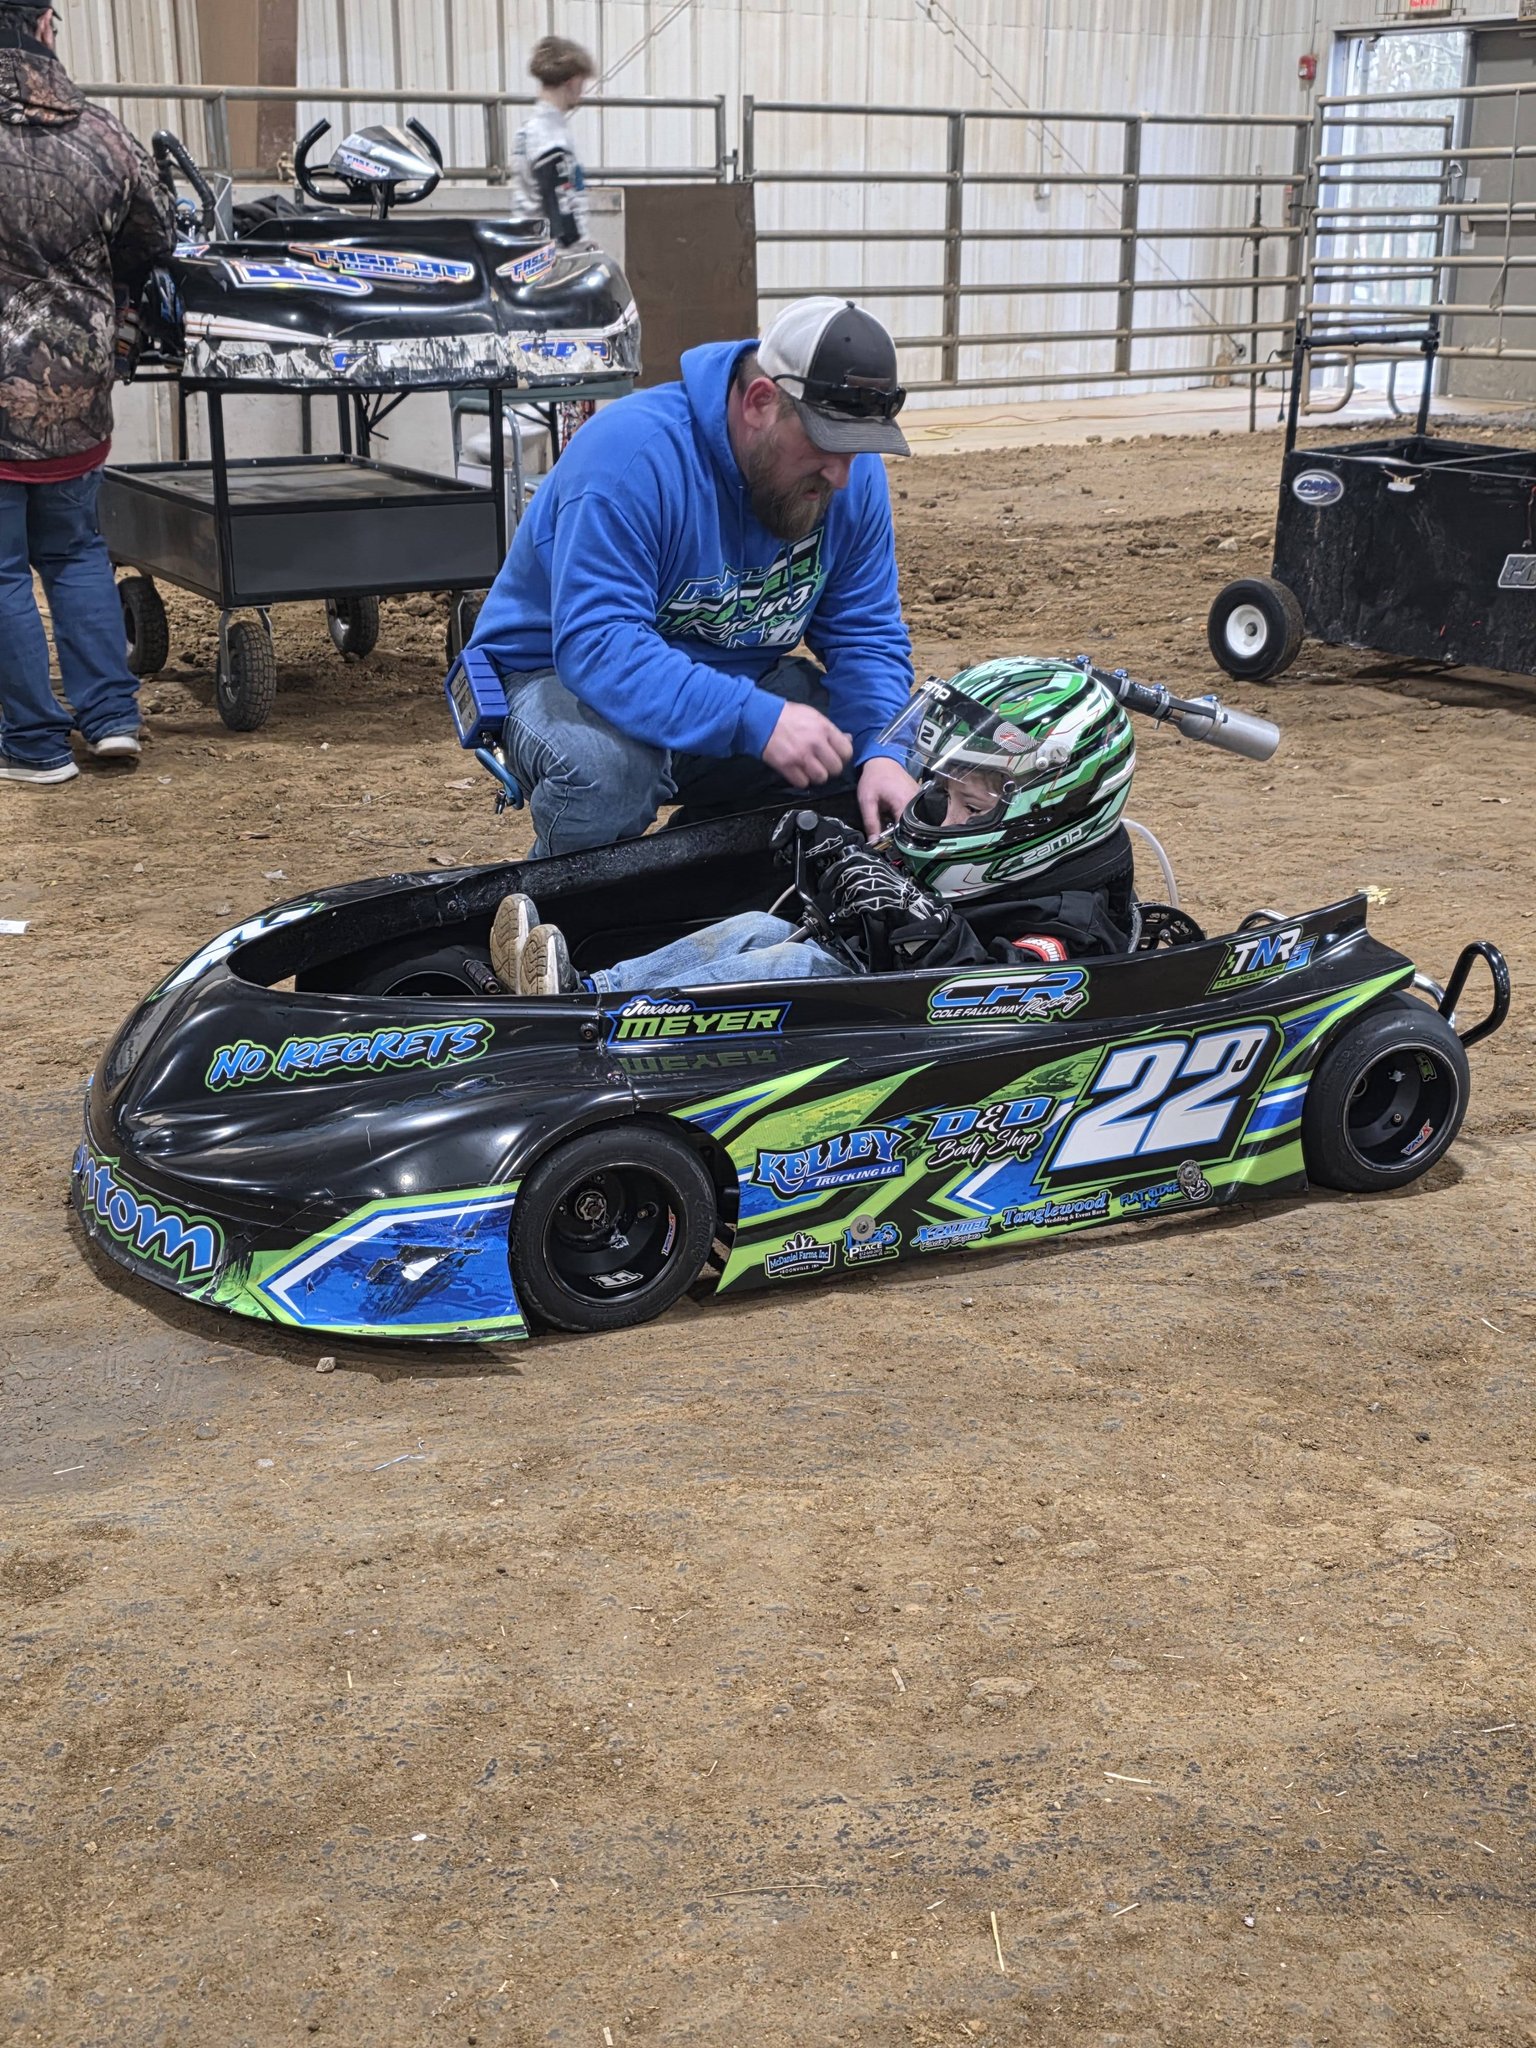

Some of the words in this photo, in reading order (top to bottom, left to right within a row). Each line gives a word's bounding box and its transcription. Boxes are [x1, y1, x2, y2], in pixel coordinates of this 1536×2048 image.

[317, 250, 400, 267] FAST
[1023, 828, 1084, 864] zamp
[622, 999, 691, 1017] Jaxson
[931, 1008, 962, 1019] COLE
[962, 1004, 1023, 1017] FALLOWAY
[1018, 992, 1084, 1017] Racing
[617, 1008, 782, 1039] MEYER
[209, 1045, 266, 1084] NO
[277, 1022, 484, 1073] REGRETS
[928, 1096, 1053, 1141] D&D
[757, 1129, 905, 1194] KELLEY
[927, 1133, 984, 1166] Body
[985, 1128, 1038, 1157] Shop
[807, 1167, 878, 1188] TRUCKING
[879, 1164, 900, 1175] LLC
[1003, 1191, 1107, 1226] Tanglewood
[1119, 1189, 1146, 1207] FLAT
[1075, 1211, 1091, 1219] Event
[849, 1243, 883, 1258] PLACE
